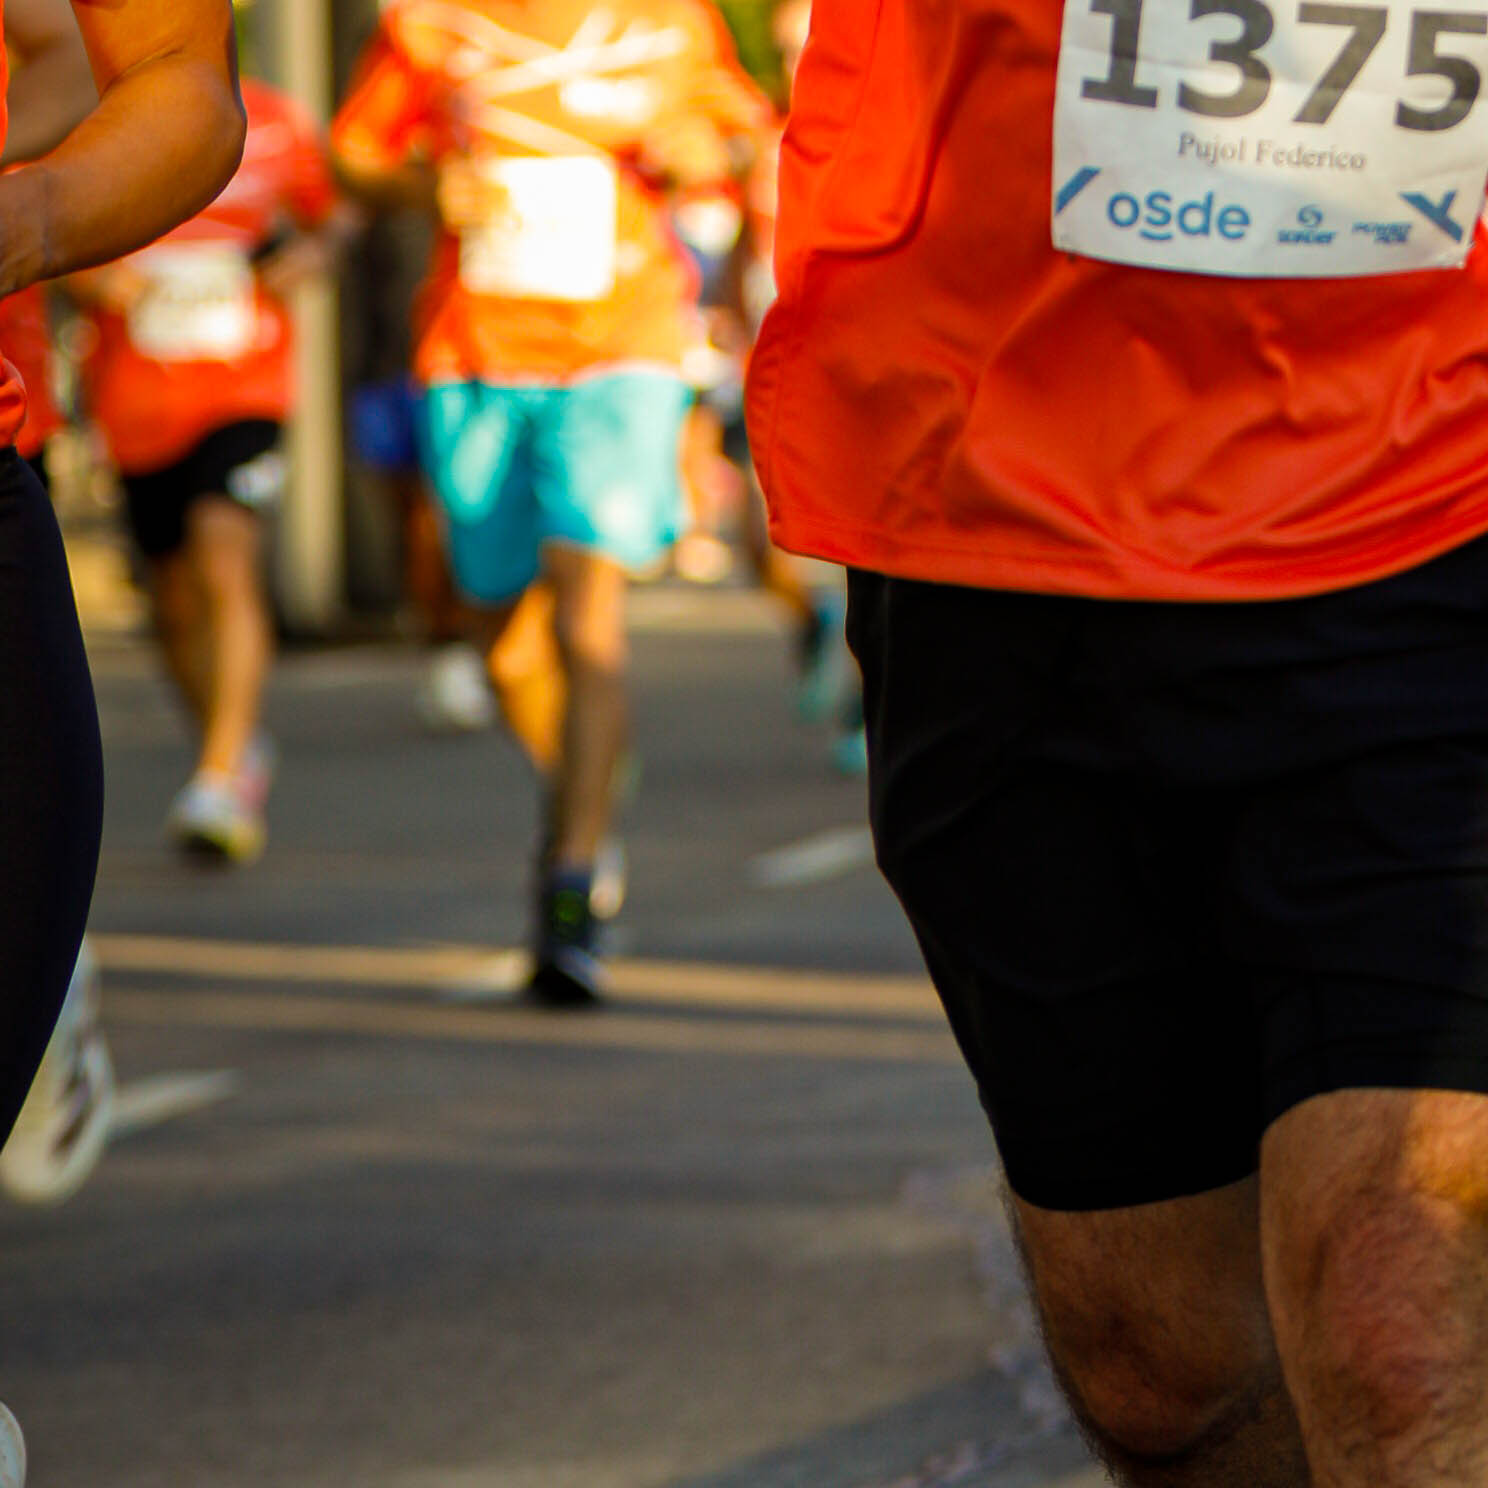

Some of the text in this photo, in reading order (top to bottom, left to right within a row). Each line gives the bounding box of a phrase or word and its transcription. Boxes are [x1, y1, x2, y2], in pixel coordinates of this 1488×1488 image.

[1177, 132, 1368, 171] Pujol Federico
[1107, 190, 1251, 240] osde
